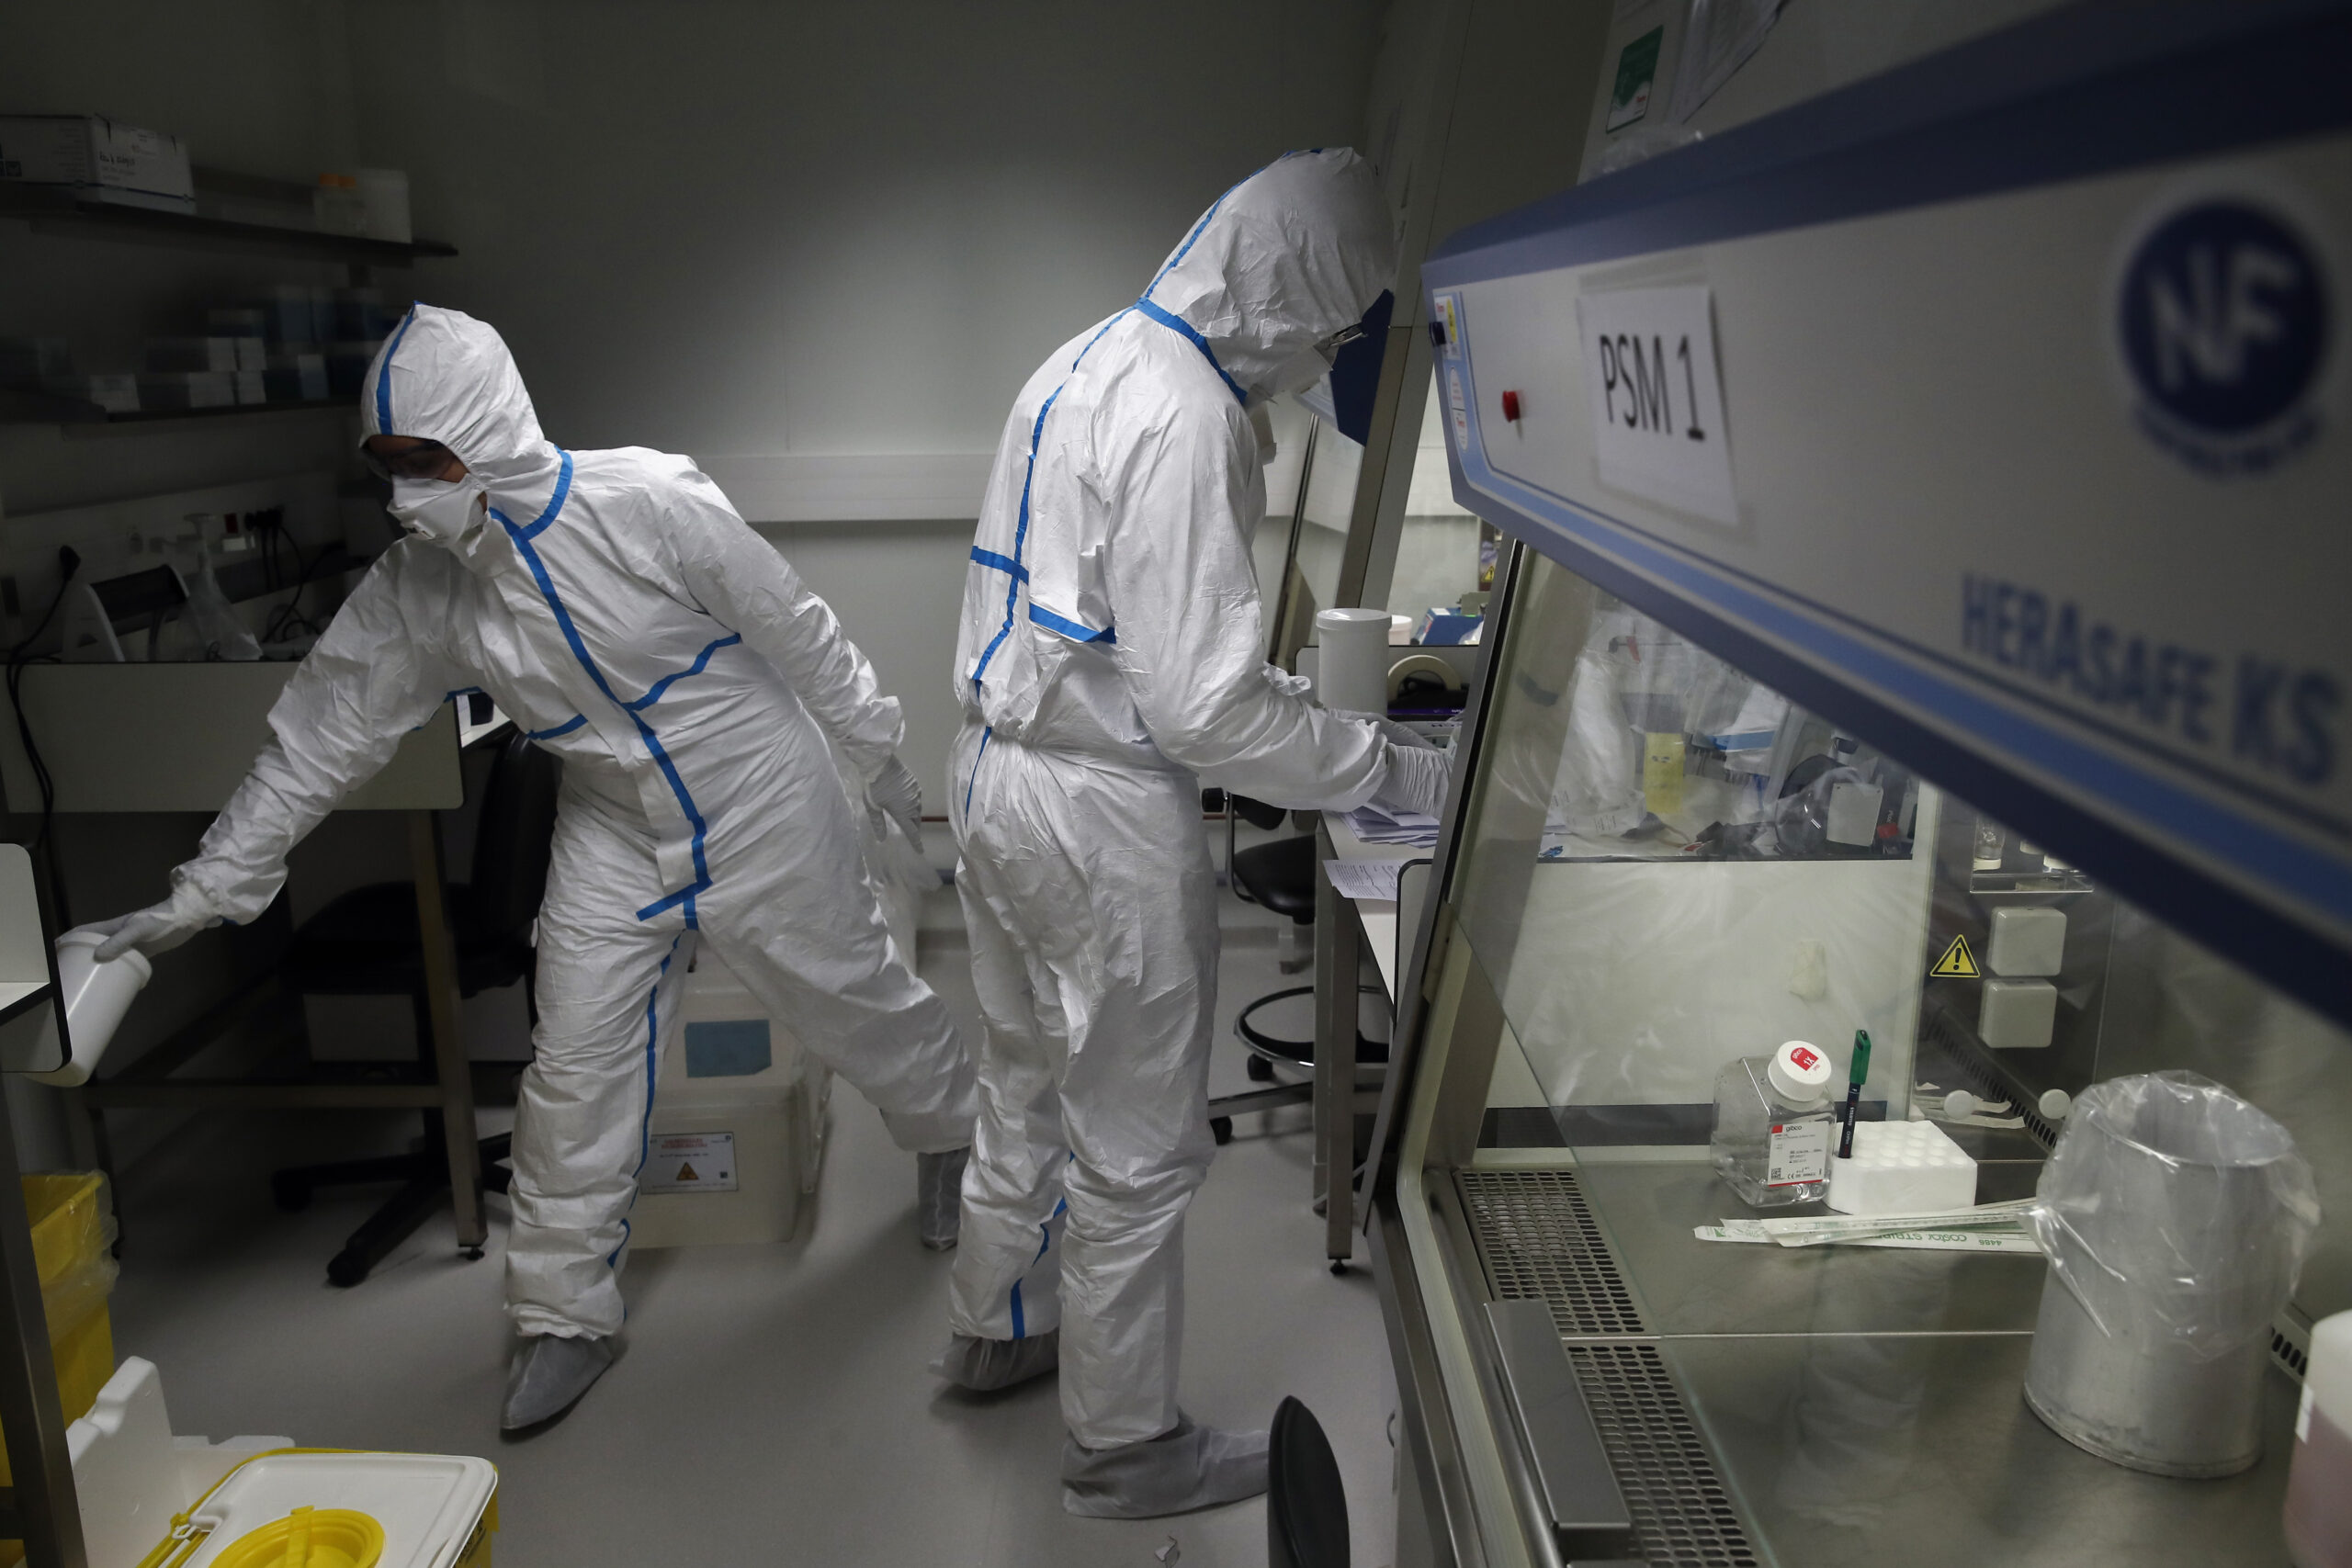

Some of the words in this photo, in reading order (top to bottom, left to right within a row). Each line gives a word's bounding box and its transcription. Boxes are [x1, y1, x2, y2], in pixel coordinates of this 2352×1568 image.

[2146, 239, 2301, 397] NF
[1600, 333, 1672, 435] PSM
[1677, 333, 1705, 441] 1
[1962, 571, 2212, 744] HERASAFE
[2233, 650, 2341, 788] KS
[1804, 1056, 1815, 1066] 1X
[1928, 1233, 1968, 1243] costar
